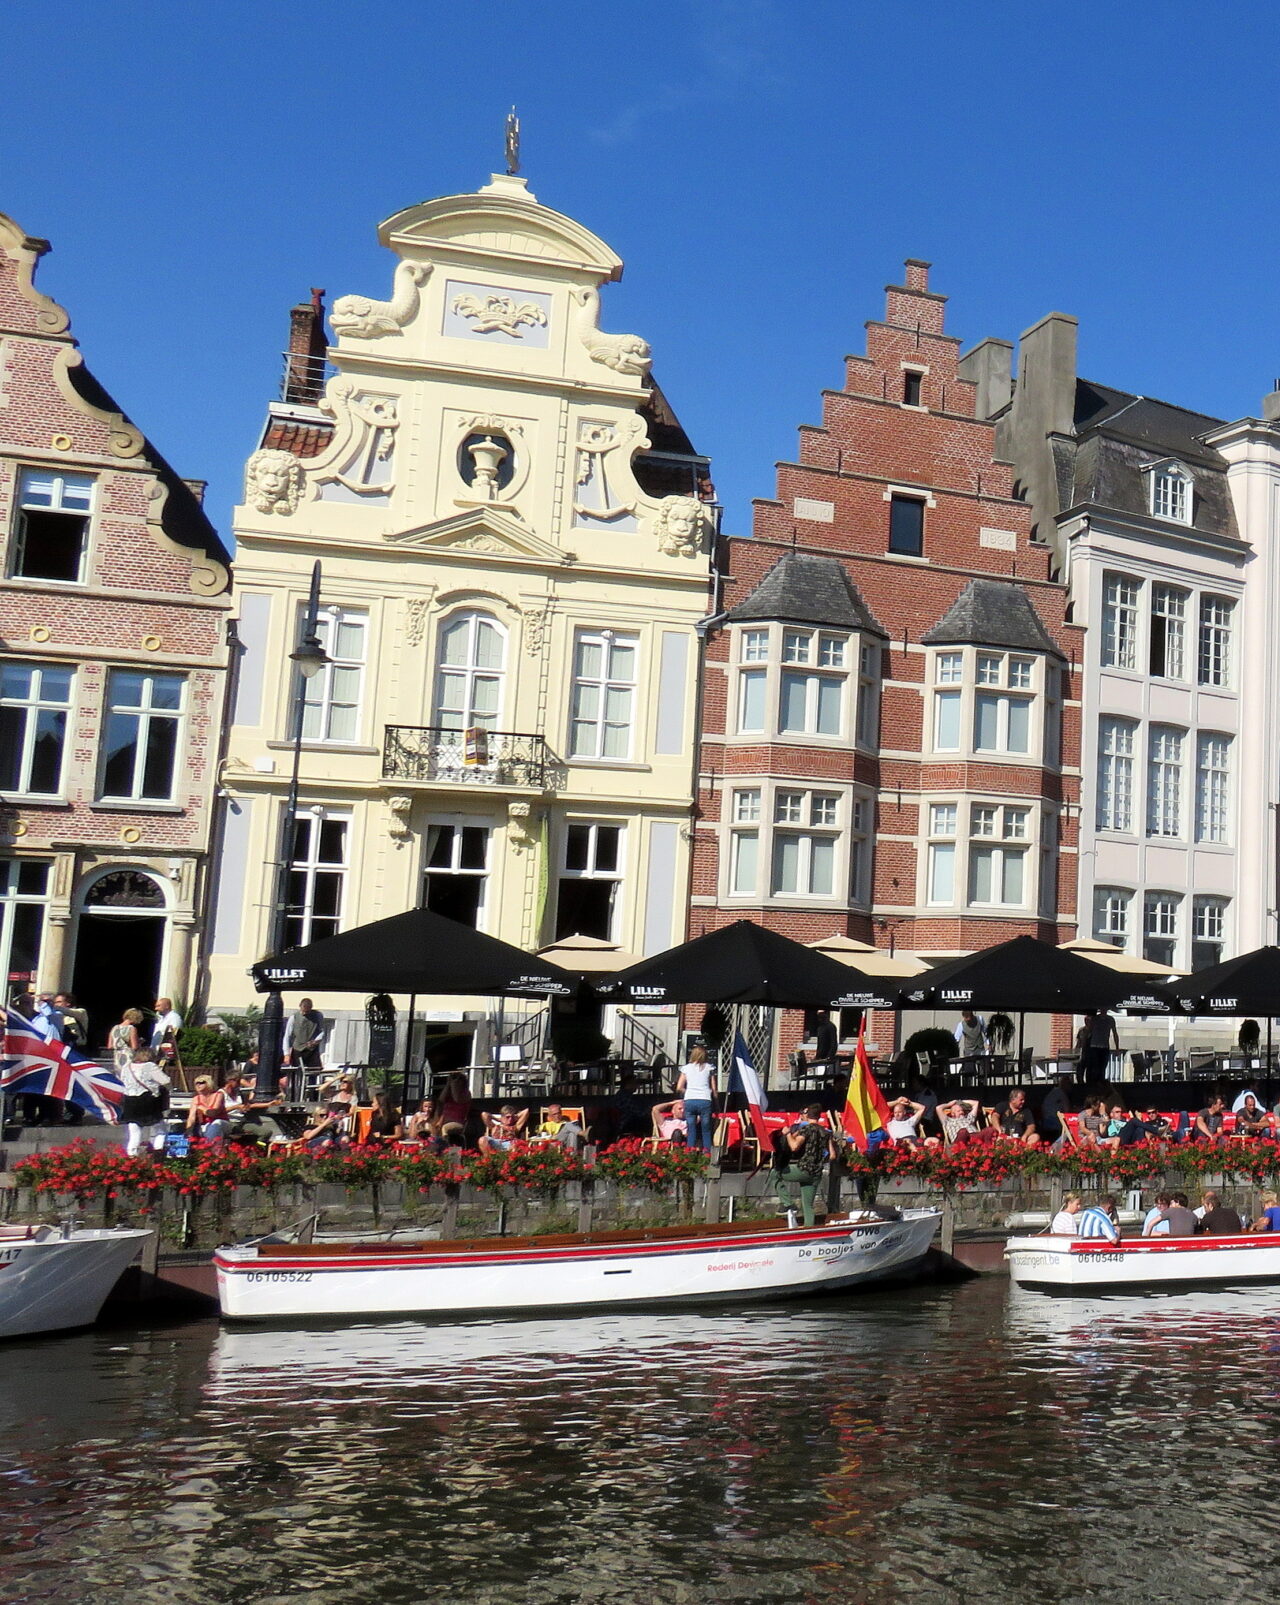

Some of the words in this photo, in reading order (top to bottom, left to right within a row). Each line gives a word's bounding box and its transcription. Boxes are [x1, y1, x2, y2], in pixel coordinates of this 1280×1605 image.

[630, 985, 667, 996] LILLET
[941, 990, 974, 1000] LILLET
[1210, 999, 1238, 1007] LILLET
[798, 1247, 812, 1258] De
[818, 1242, 854, 1259] bootjes
[859, 1241, 877, 1251] van
[1077, 1253, 1125, 1264] 06105448
[706, 1262, 737, 1273] Rederij
[246, 1271, 314, 1283] 06105522
